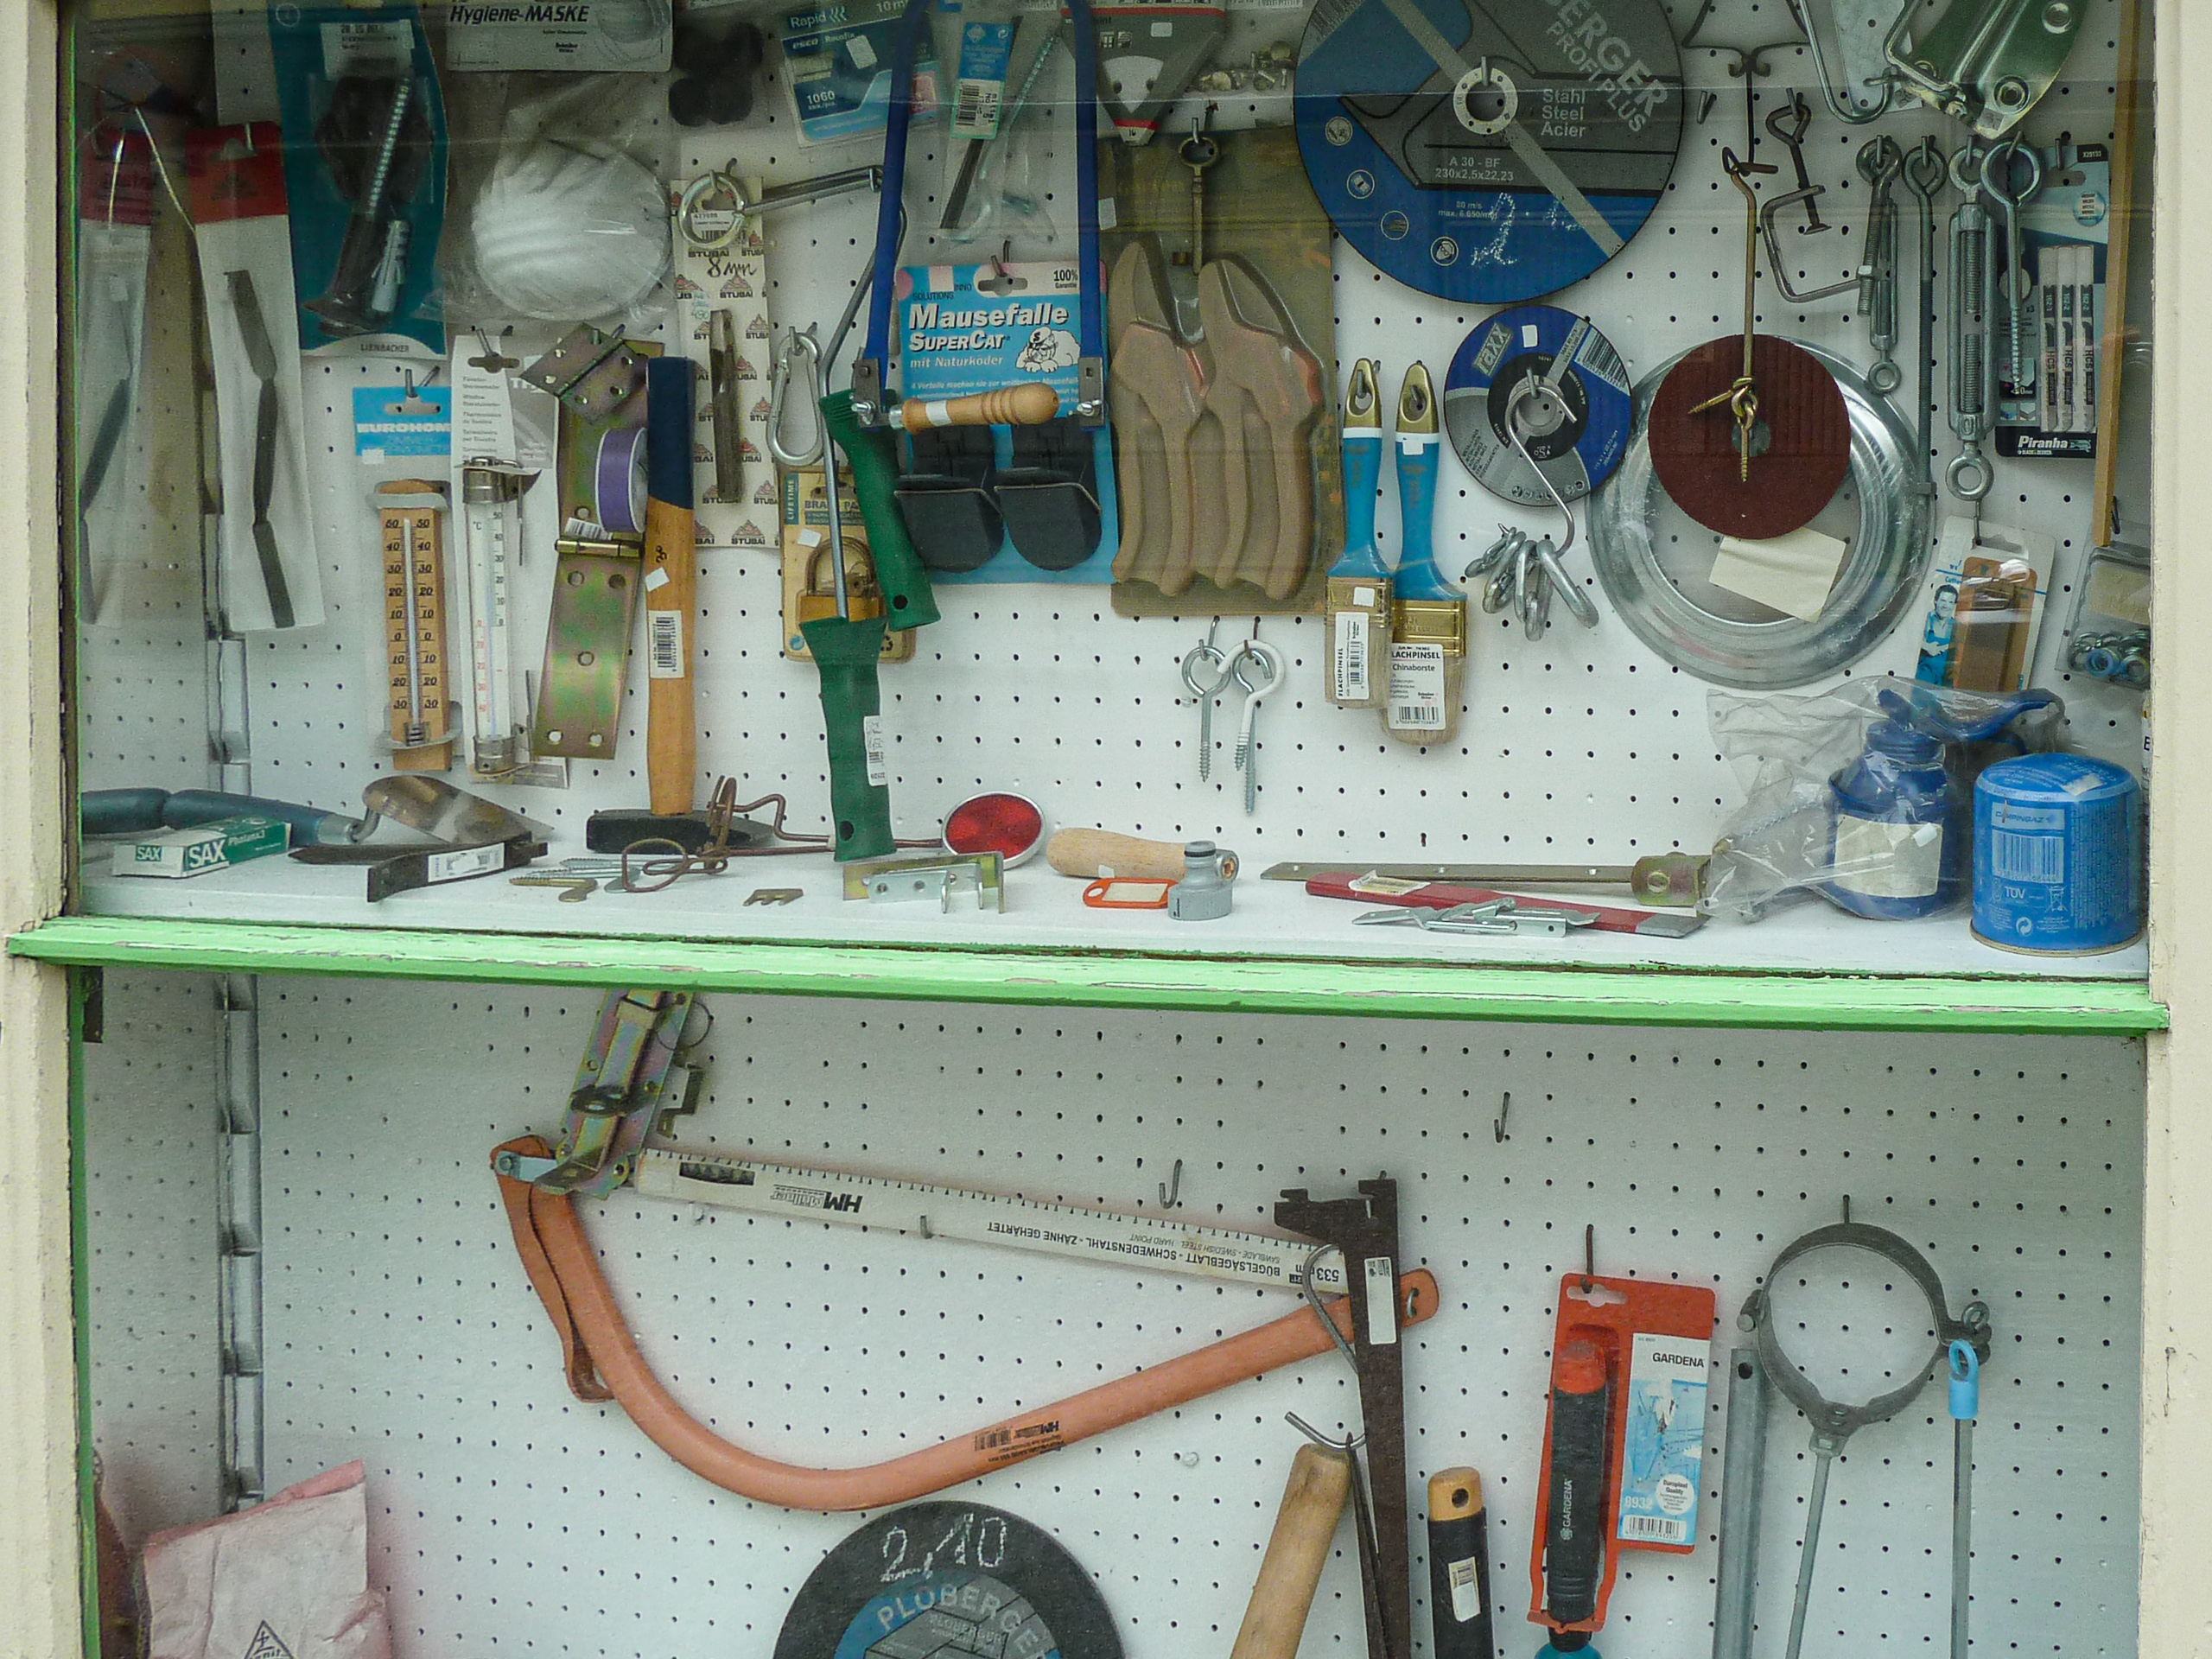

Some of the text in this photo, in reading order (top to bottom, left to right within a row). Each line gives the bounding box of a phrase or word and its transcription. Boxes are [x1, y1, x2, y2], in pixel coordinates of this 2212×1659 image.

[450, 5, 589, 24] Hygiene-MASKE
[790, 11, 827, 29] Rapid
[1542, 89, 1586, 104] Stahl
[1541, 105, 1584, 121] Steel
[1541, 121, 1586, 137] Acier
[1449, 156, 1458, 167] A
[1461, 157, 1474, 167] 30
[1053, 269, 1079, 282] 100%
[909, 302, 1069, 330] Mausefalle
[911, 355, 1003, 367] mit Naturköder
[2047, 351, 2056, 370] HCS
[2085, 350, 2094, 369] HCS
[357, 423, 451, 433] EUROHOM
[2018, 435, 2069, 448] Piranha
[385, 519, 398, 528] 50
[416, 519, 429, 528] 50
[386, 542, 399, 550] 40
[417, 542, 431, 550] 40
[387, 564, 401, 573] 30
[418, 564, 432, 573] 30
[388, 587, 403, 596] 20
[420, 587, 433, 595] 20
[390, 610, 403, 619] 10
[422, 609, 434, 618] 10
[394, 632, 401, 641] 0
[424, 632, 431, 641] 0
[392, 655, 404, 664] 10
[423, 655, 436, 664] 10
[1391, 650, 1440, 659] LACHPINSEL
[1392, 663, 1435, 672] Chinaborste
[392, 677, 406, 686] 20
[423, 677, 437, 686] 20
[393, 700, 407, 709] 30
[424, 700, 438, 709] 30
[137, 847, 162, 861] SAX
[188, 839, 226, 868] SAX
[823, 1192, 863, 1213] HM
[987, 1222, 1041, 1239] GEHÄRTET
[1044, 1230, 1077, 1245] ZÄHNE
[1154, 1236, 1174, 1247] HARD
[1086, 1237, 1177, 1260] SCHWEDENSTAHL
[1181, 1240, 1203, 1251] STEEL
[1185, 1255, 1281, 1276] BÜGELSÄGEBLATT
[1317, 1268, 1339, 1282] 533
[1652, 1352, 1705, 1368] GARDENA
[1562, 1479, 1573, 1528] GARDENA
[1625, 1495, 1653, 1510] 8932
